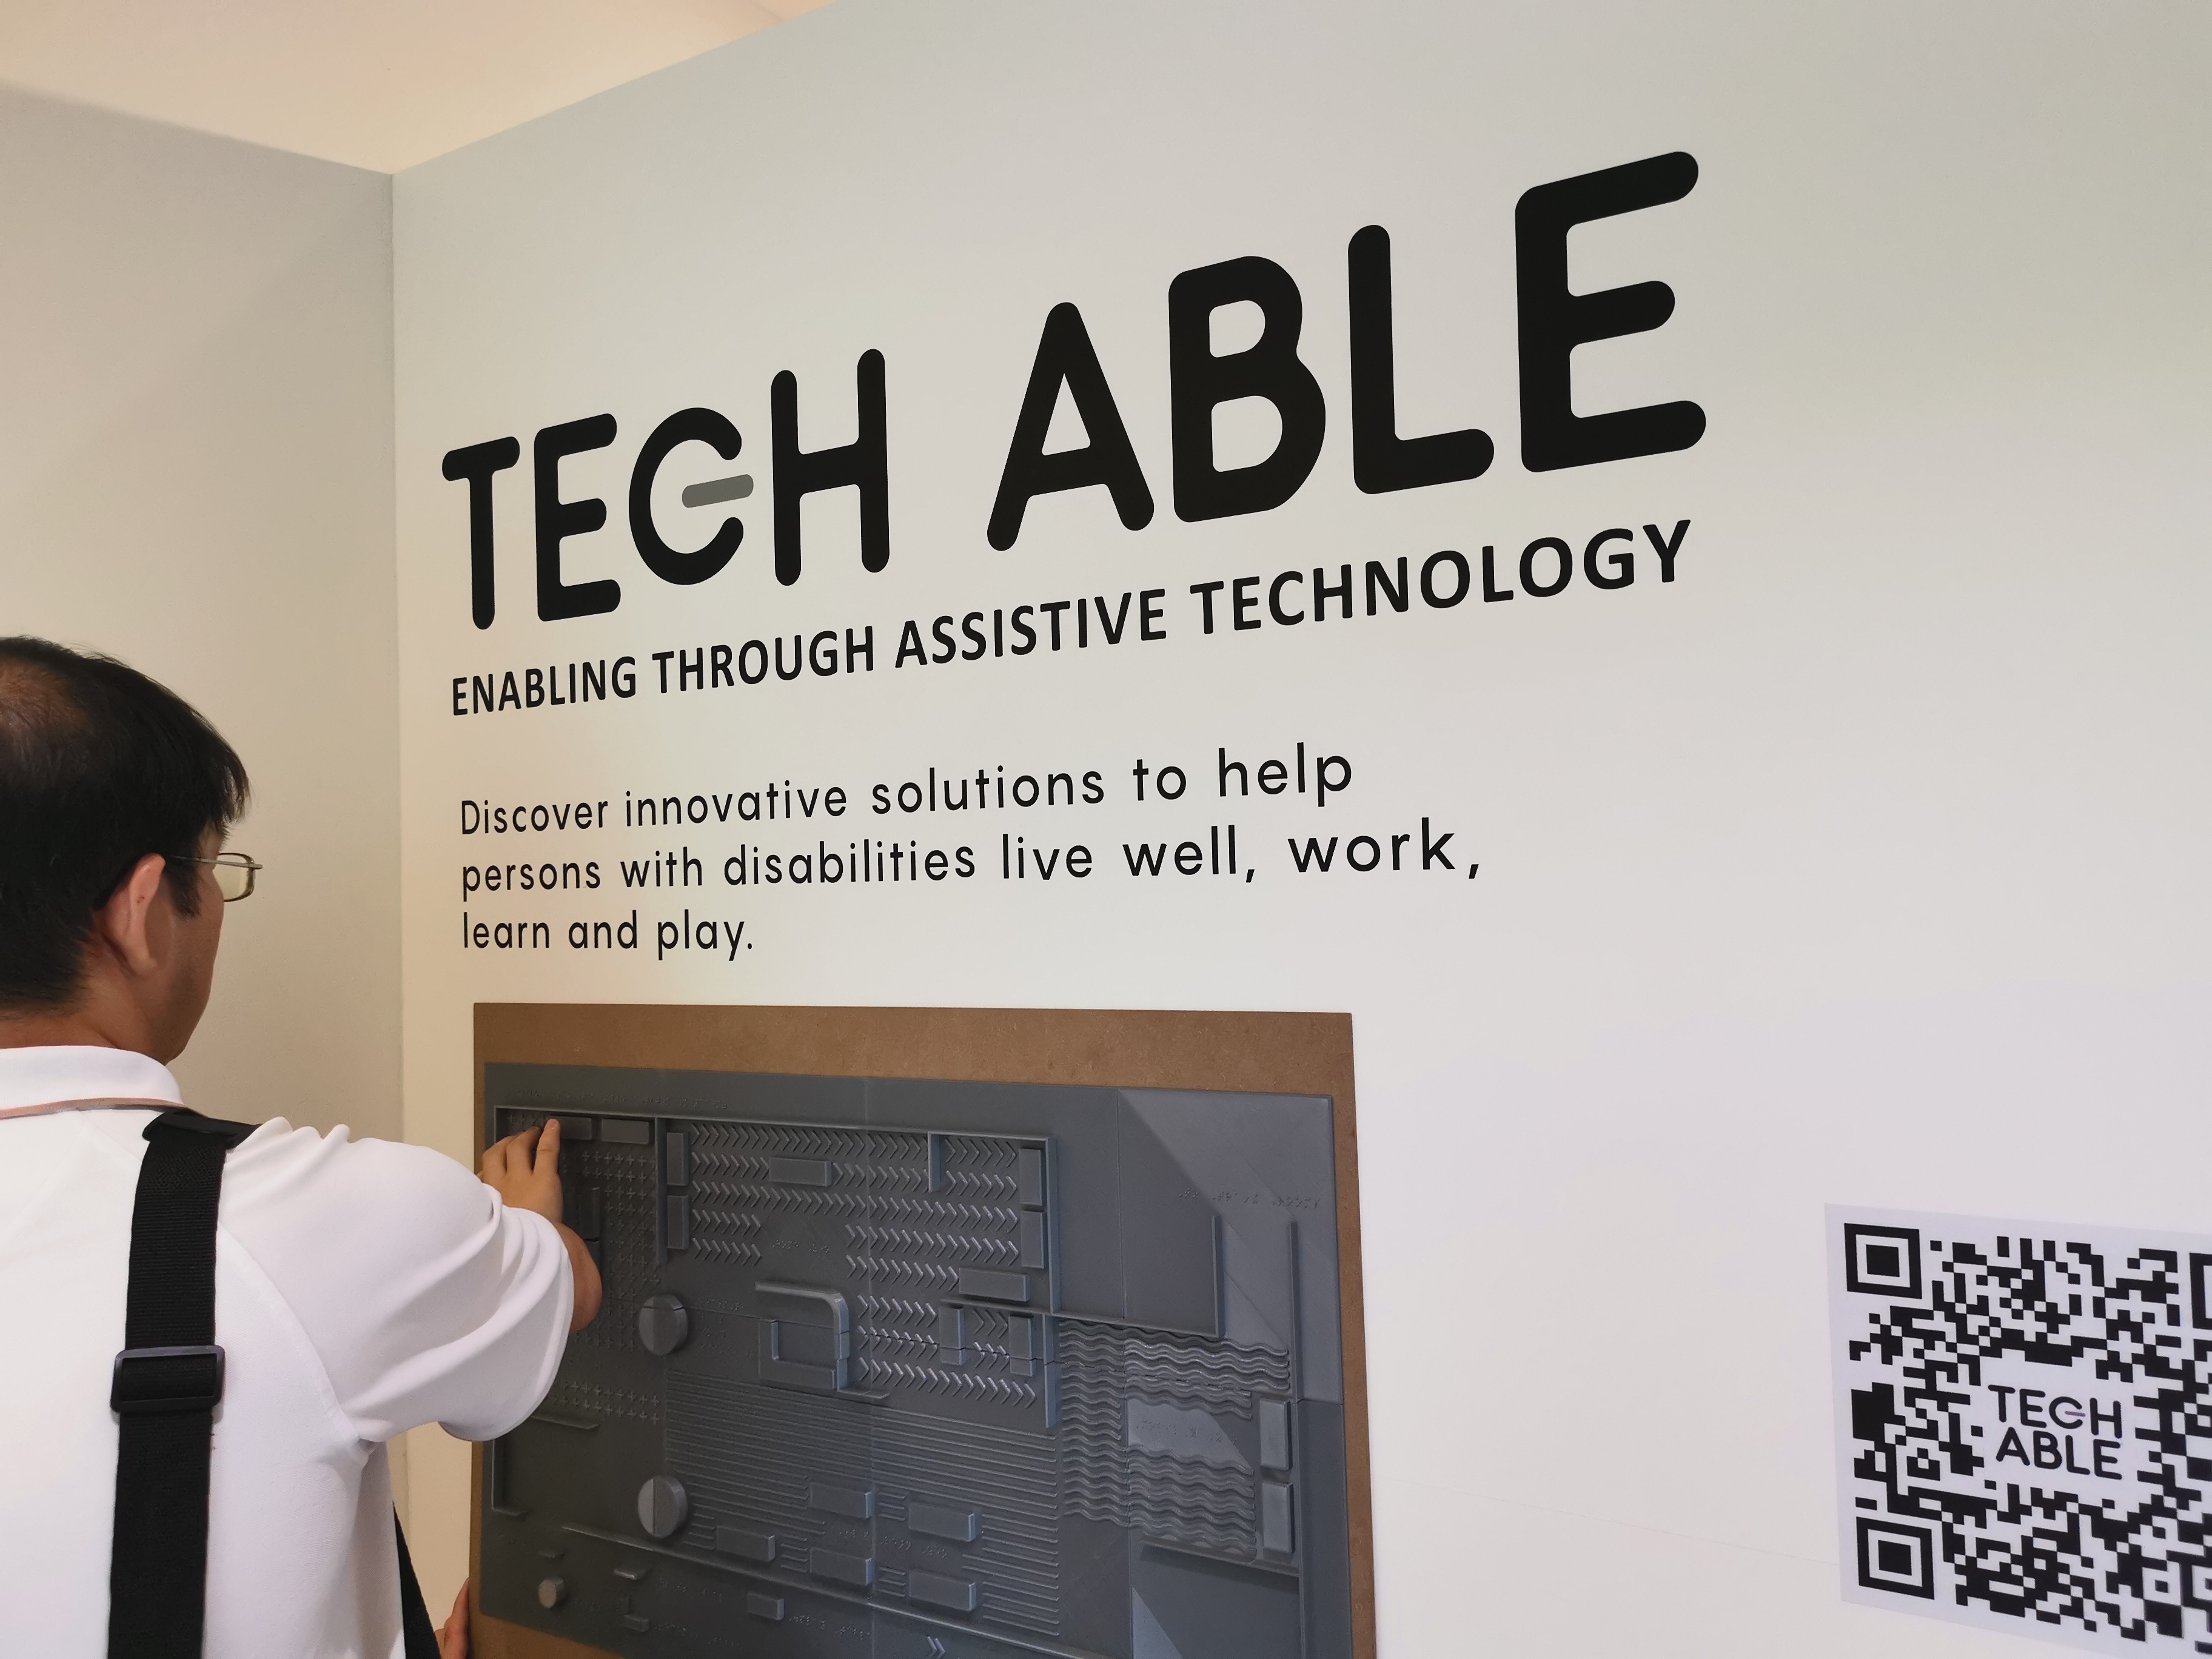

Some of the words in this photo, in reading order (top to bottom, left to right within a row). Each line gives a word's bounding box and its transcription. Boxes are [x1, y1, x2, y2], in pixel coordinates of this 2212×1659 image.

[441, 349, 890, 630] TECH
[987, 151, 1706, 552] ABLE
[452, 656, 636, 716] ENABLING
[652, 625, 874, 694] THROUGH
[894, 588, 1167, 668] ASSISTIVE
[1190, 519, 1692, 635] TECHNOLOGY
[461, 797, 609, 835] Discover
[626, 779, 846, 827] innovative
[872, 765, 1104, 814] solutions
[1133, 759, 1187, 801] to
[1218, 742, 1352, 808] help
[463, 862, 601, 902] persons
[620, 846, 703, 888] with
[724, 839, 975, 886] disabilities
[1002, 833, 1093, 880] live
[1122, 825, 1255, 883] well,
[1287, 817, 1480, 879] work,
[463, 911, 550, 949] learn
[568, 910, 637, 950] and
[657, 909, 753, 962] play.
[1988, 1384, 2122, 1439] TECH
[1996, 1427, 2123, 1480] ABLE
